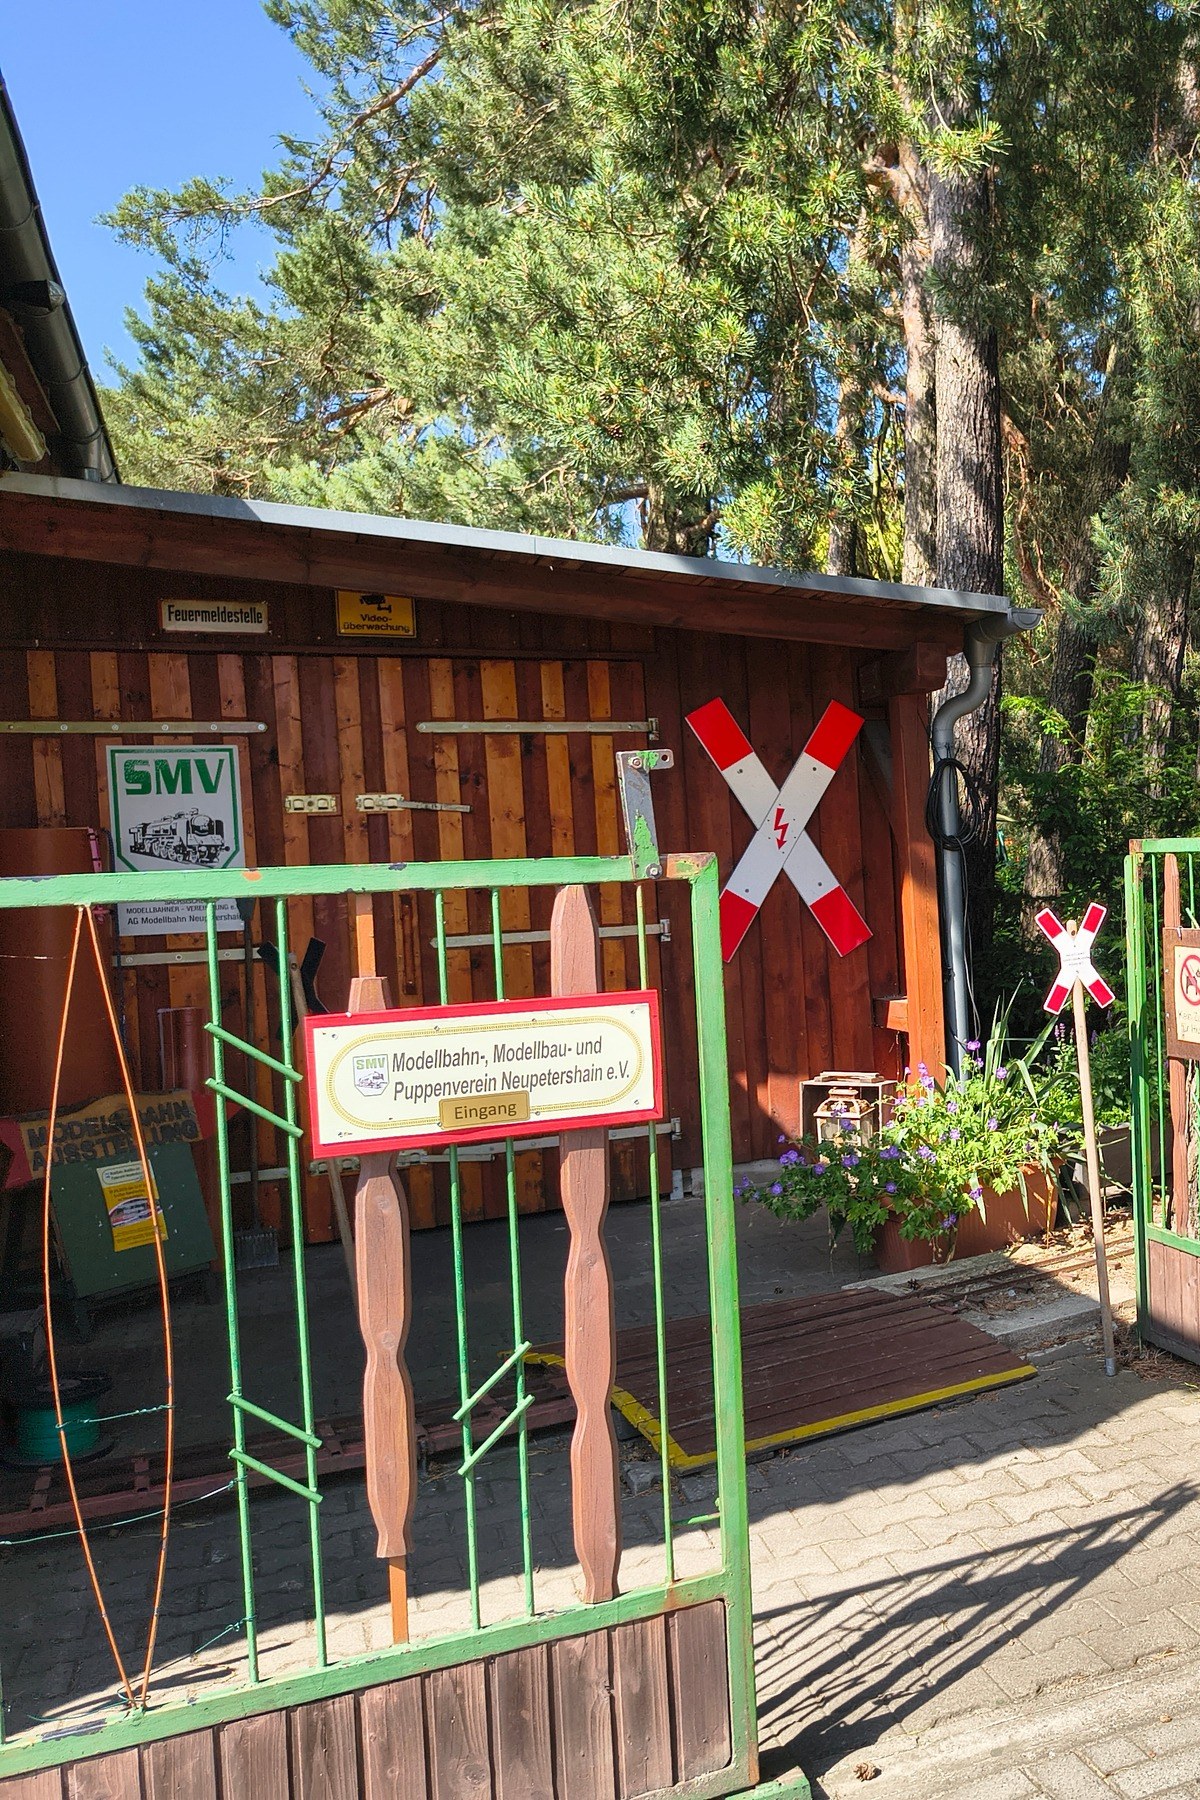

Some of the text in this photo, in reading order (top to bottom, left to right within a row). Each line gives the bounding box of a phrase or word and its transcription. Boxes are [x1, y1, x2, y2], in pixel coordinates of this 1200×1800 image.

[167, 604, 264, 624] Feuermeldestelle
[359, 614, 393, 623] Video-
[343, 621, 410, 633] überwachung
[123, 758, 225, 796] SMV
[126, 905, 180, 915] MODELLBAHNER
[127, 917, 139, 925] AG
[141, 914, 187, 925] Modellbahn
[392, 1035, 602, 1073] Modellbahn-, Modellbau- und
[355, 1056, 386, 1070] SMV
[393, 1060, 630, 1104] Puppenverein Neupetershain e.V.
[454, 1101, 517, 1121] Eingang
